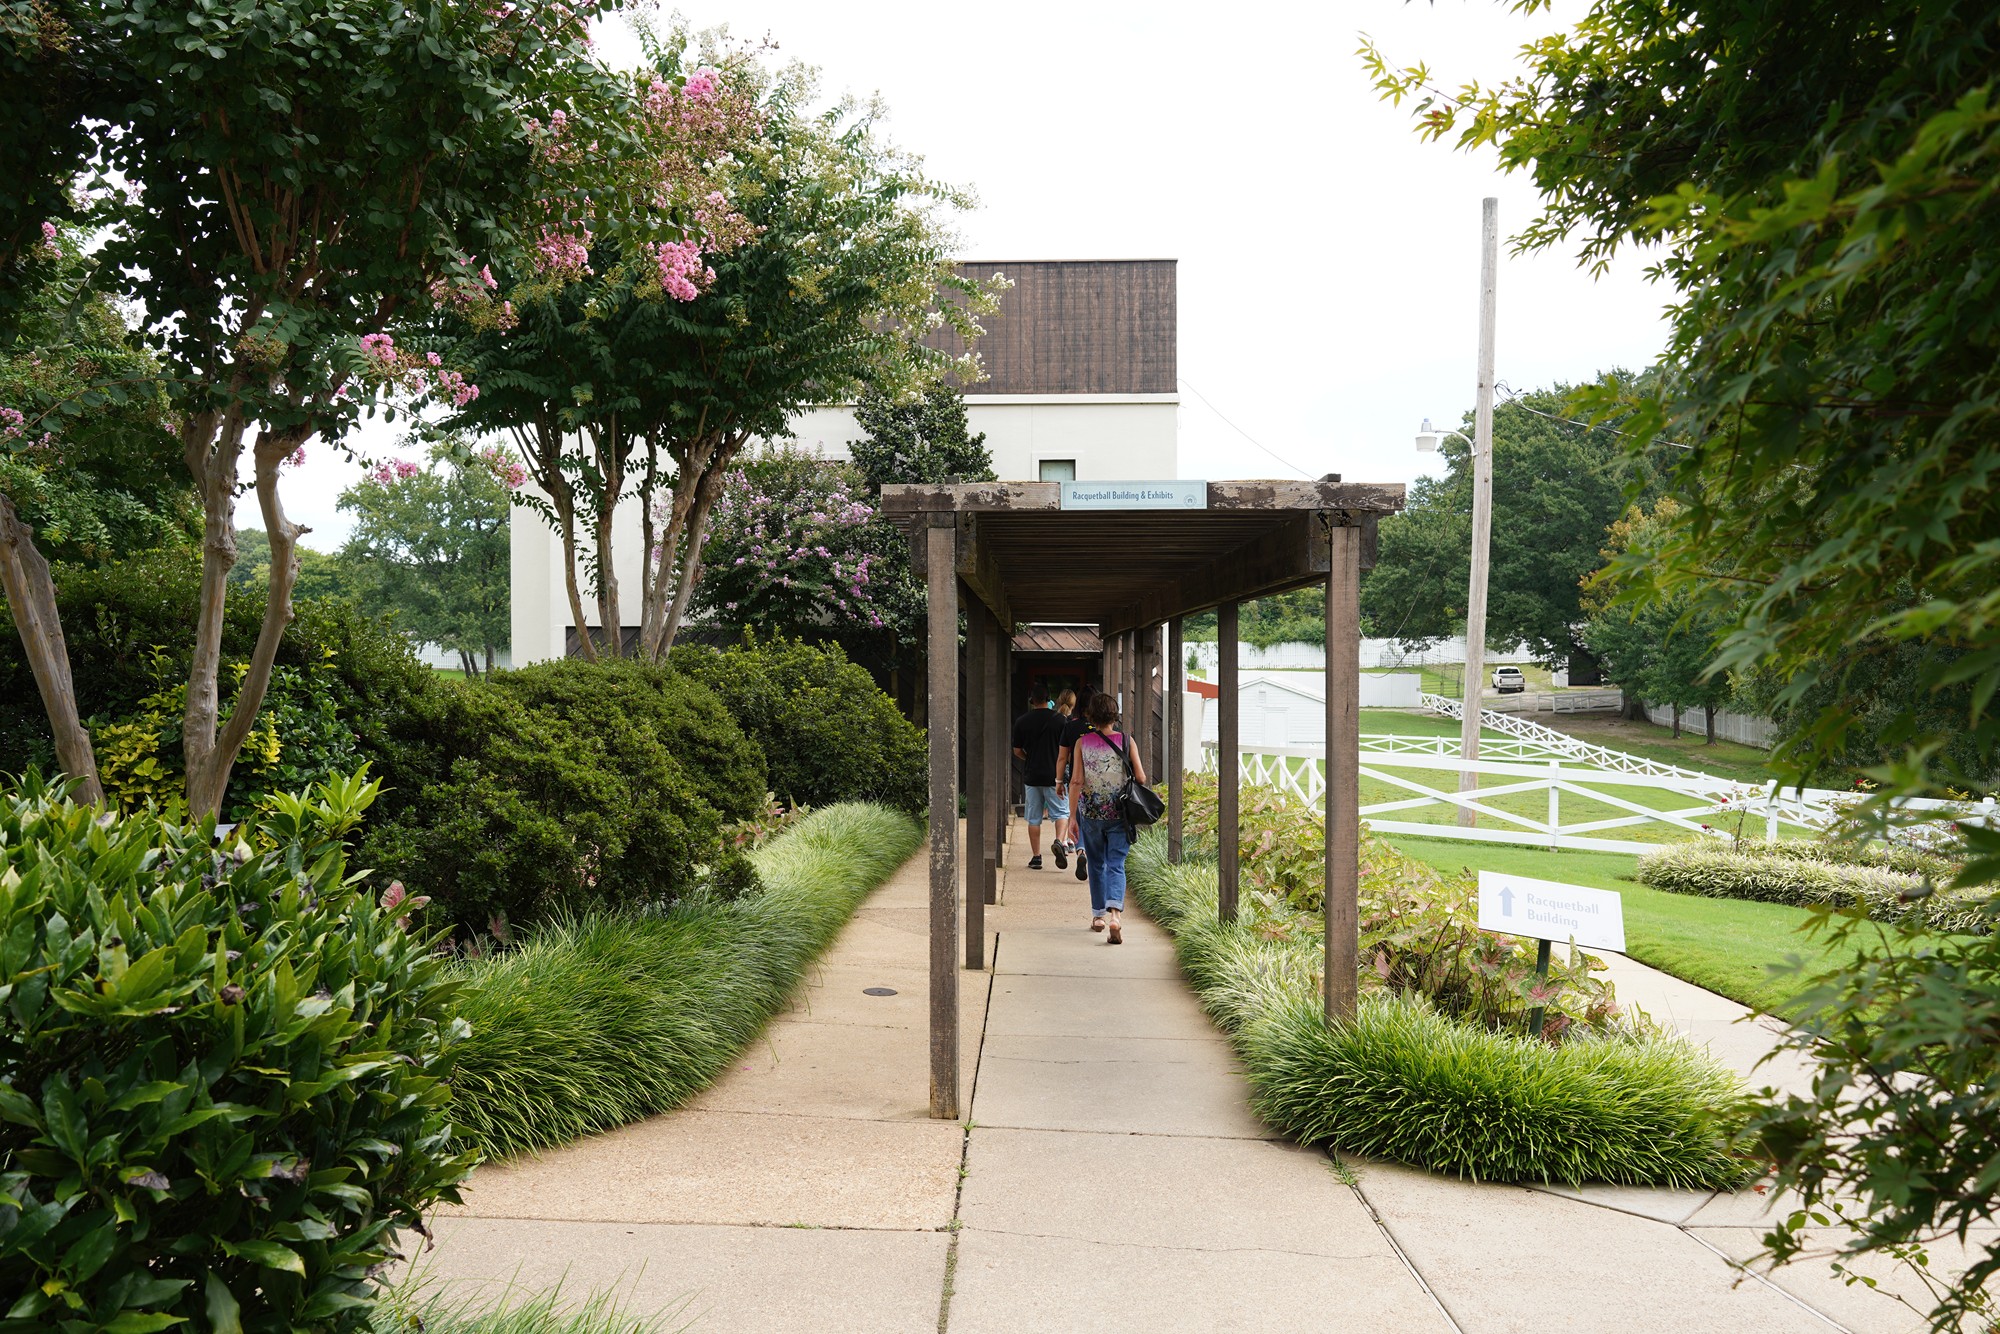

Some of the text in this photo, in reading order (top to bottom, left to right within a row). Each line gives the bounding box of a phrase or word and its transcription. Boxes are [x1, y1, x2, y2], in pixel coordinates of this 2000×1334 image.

[1072, 490, 1174, 501] Racquetball Building & Exhibits
[1527, 893, 1599, 914] Racquetball
[1527, 909, 1578, 929] Building
